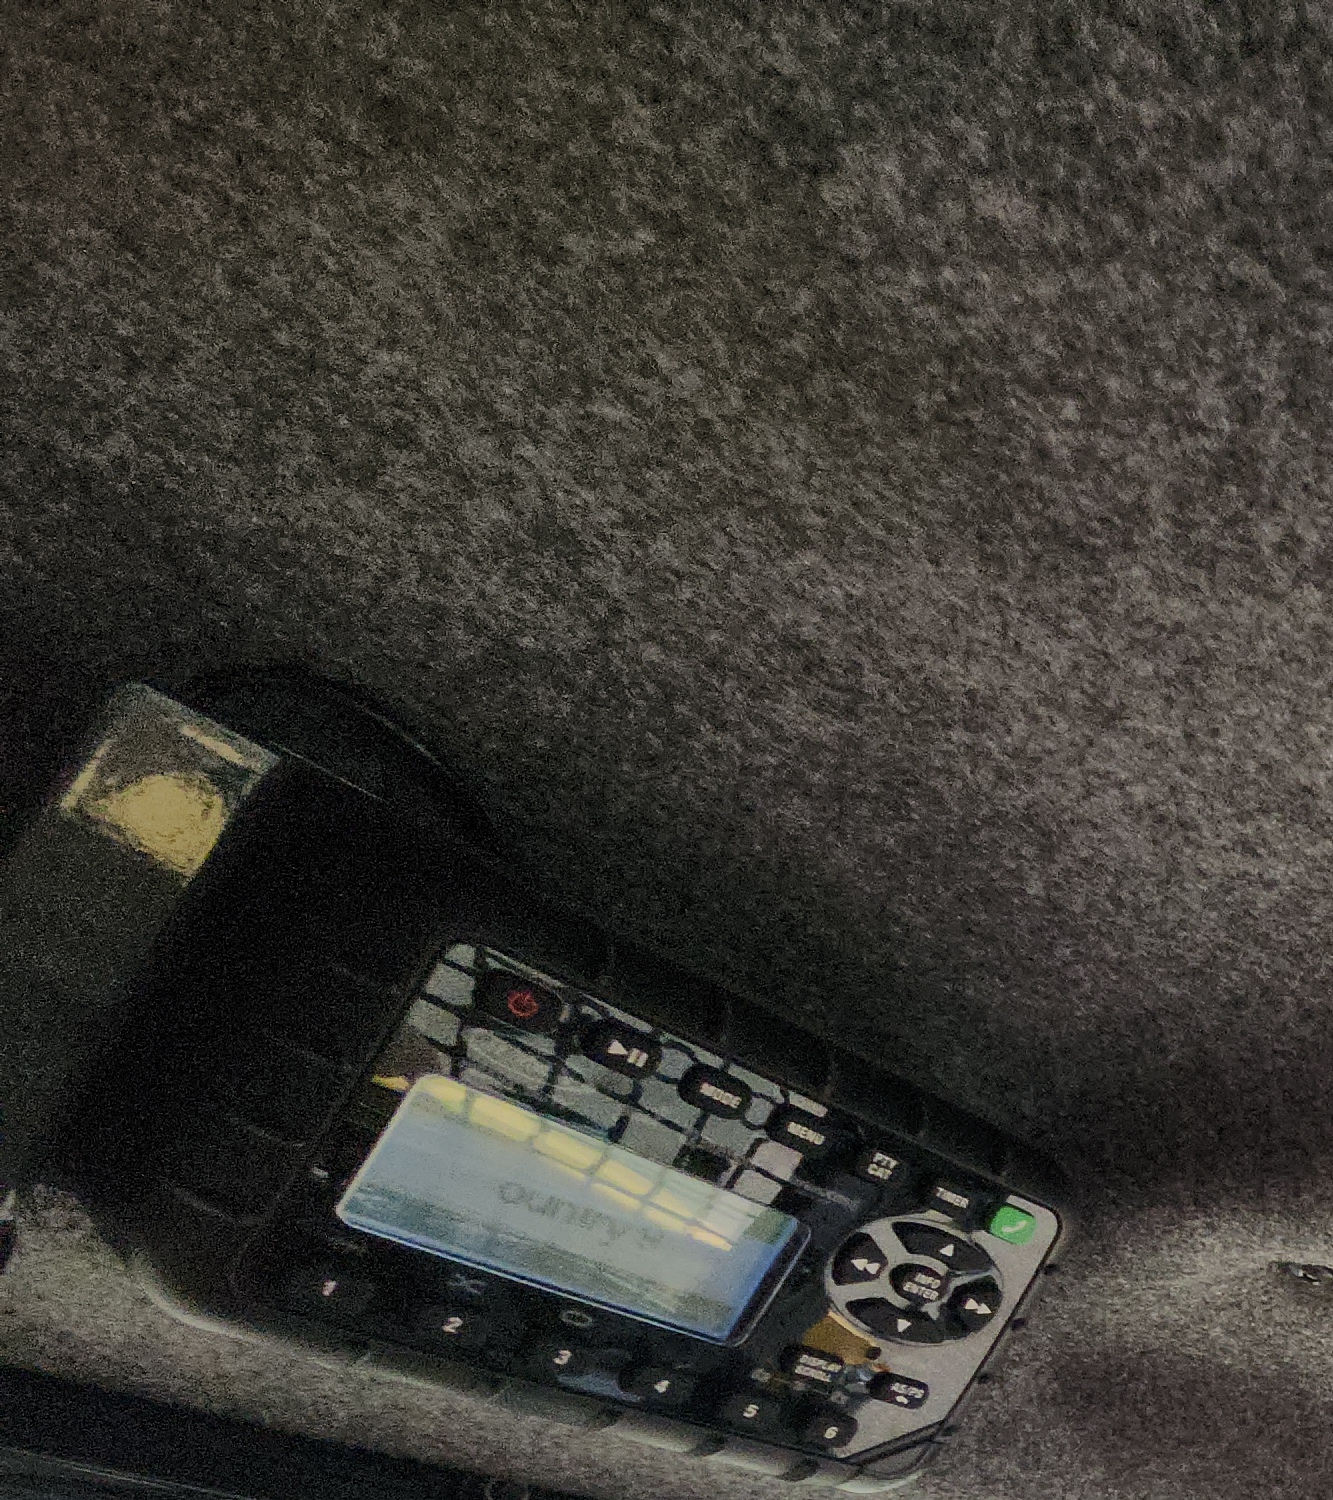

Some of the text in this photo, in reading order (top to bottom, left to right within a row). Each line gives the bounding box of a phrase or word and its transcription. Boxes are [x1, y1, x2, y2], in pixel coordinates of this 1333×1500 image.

[699, 1082, 742, 1109] MODE
[787, 1121, 825, 1146] MENU
[322, 1279, 336, 1297] 1
[914, 1272, 942, 1289] INFO
[902, 1281, 940, 1301] ENTER
[441, 1317, 463, 1333] 2
[553, 1349, 571, 1365] 3
[653, 1379, 671, 1394] 4
[890, 1382, 925, 1399] AS/PS
[742, 1403, 760, 1418] 5
[823, 1426, 839, 1439] 6
